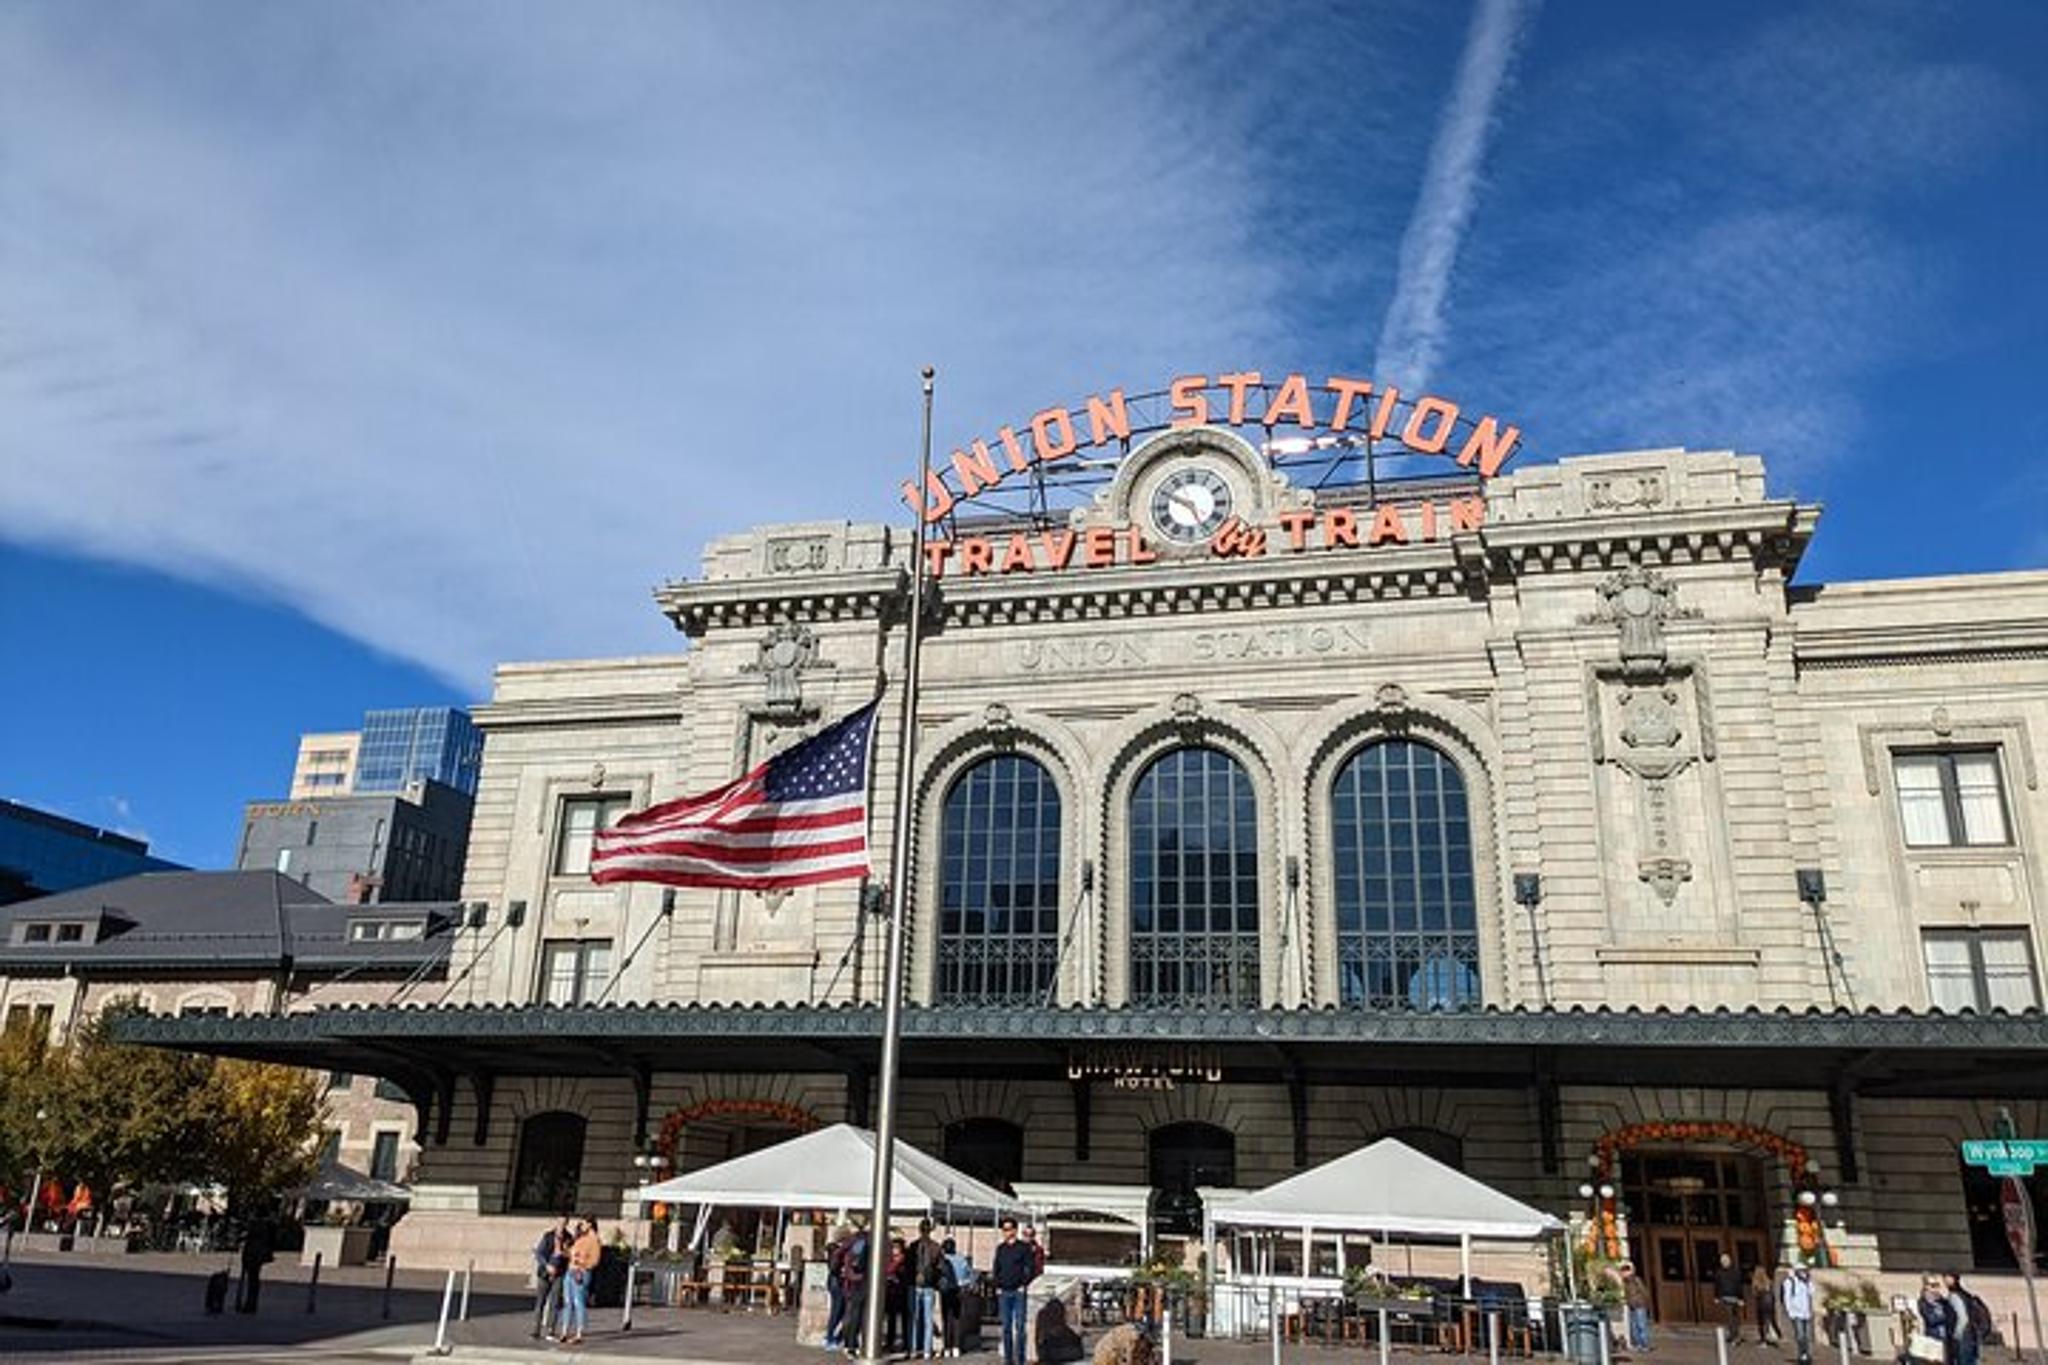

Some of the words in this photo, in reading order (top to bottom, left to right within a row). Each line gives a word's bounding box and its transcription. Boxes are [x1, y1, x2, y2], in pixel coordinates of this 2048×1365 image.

[901, 387, 1131, 524] UNION
[1170, 371, 1521, 477] STATION
[925, 524, 1157, 577] TRAVEL
[1213, 516, 1268, 558] by
[1281, 496, 1485, 550] TRAIN
[1017, 638, 1149, 672] UNION
[1192, 623, 1372, 661] STATION
[1114, 1075, 1175, 1090] HOTEL
